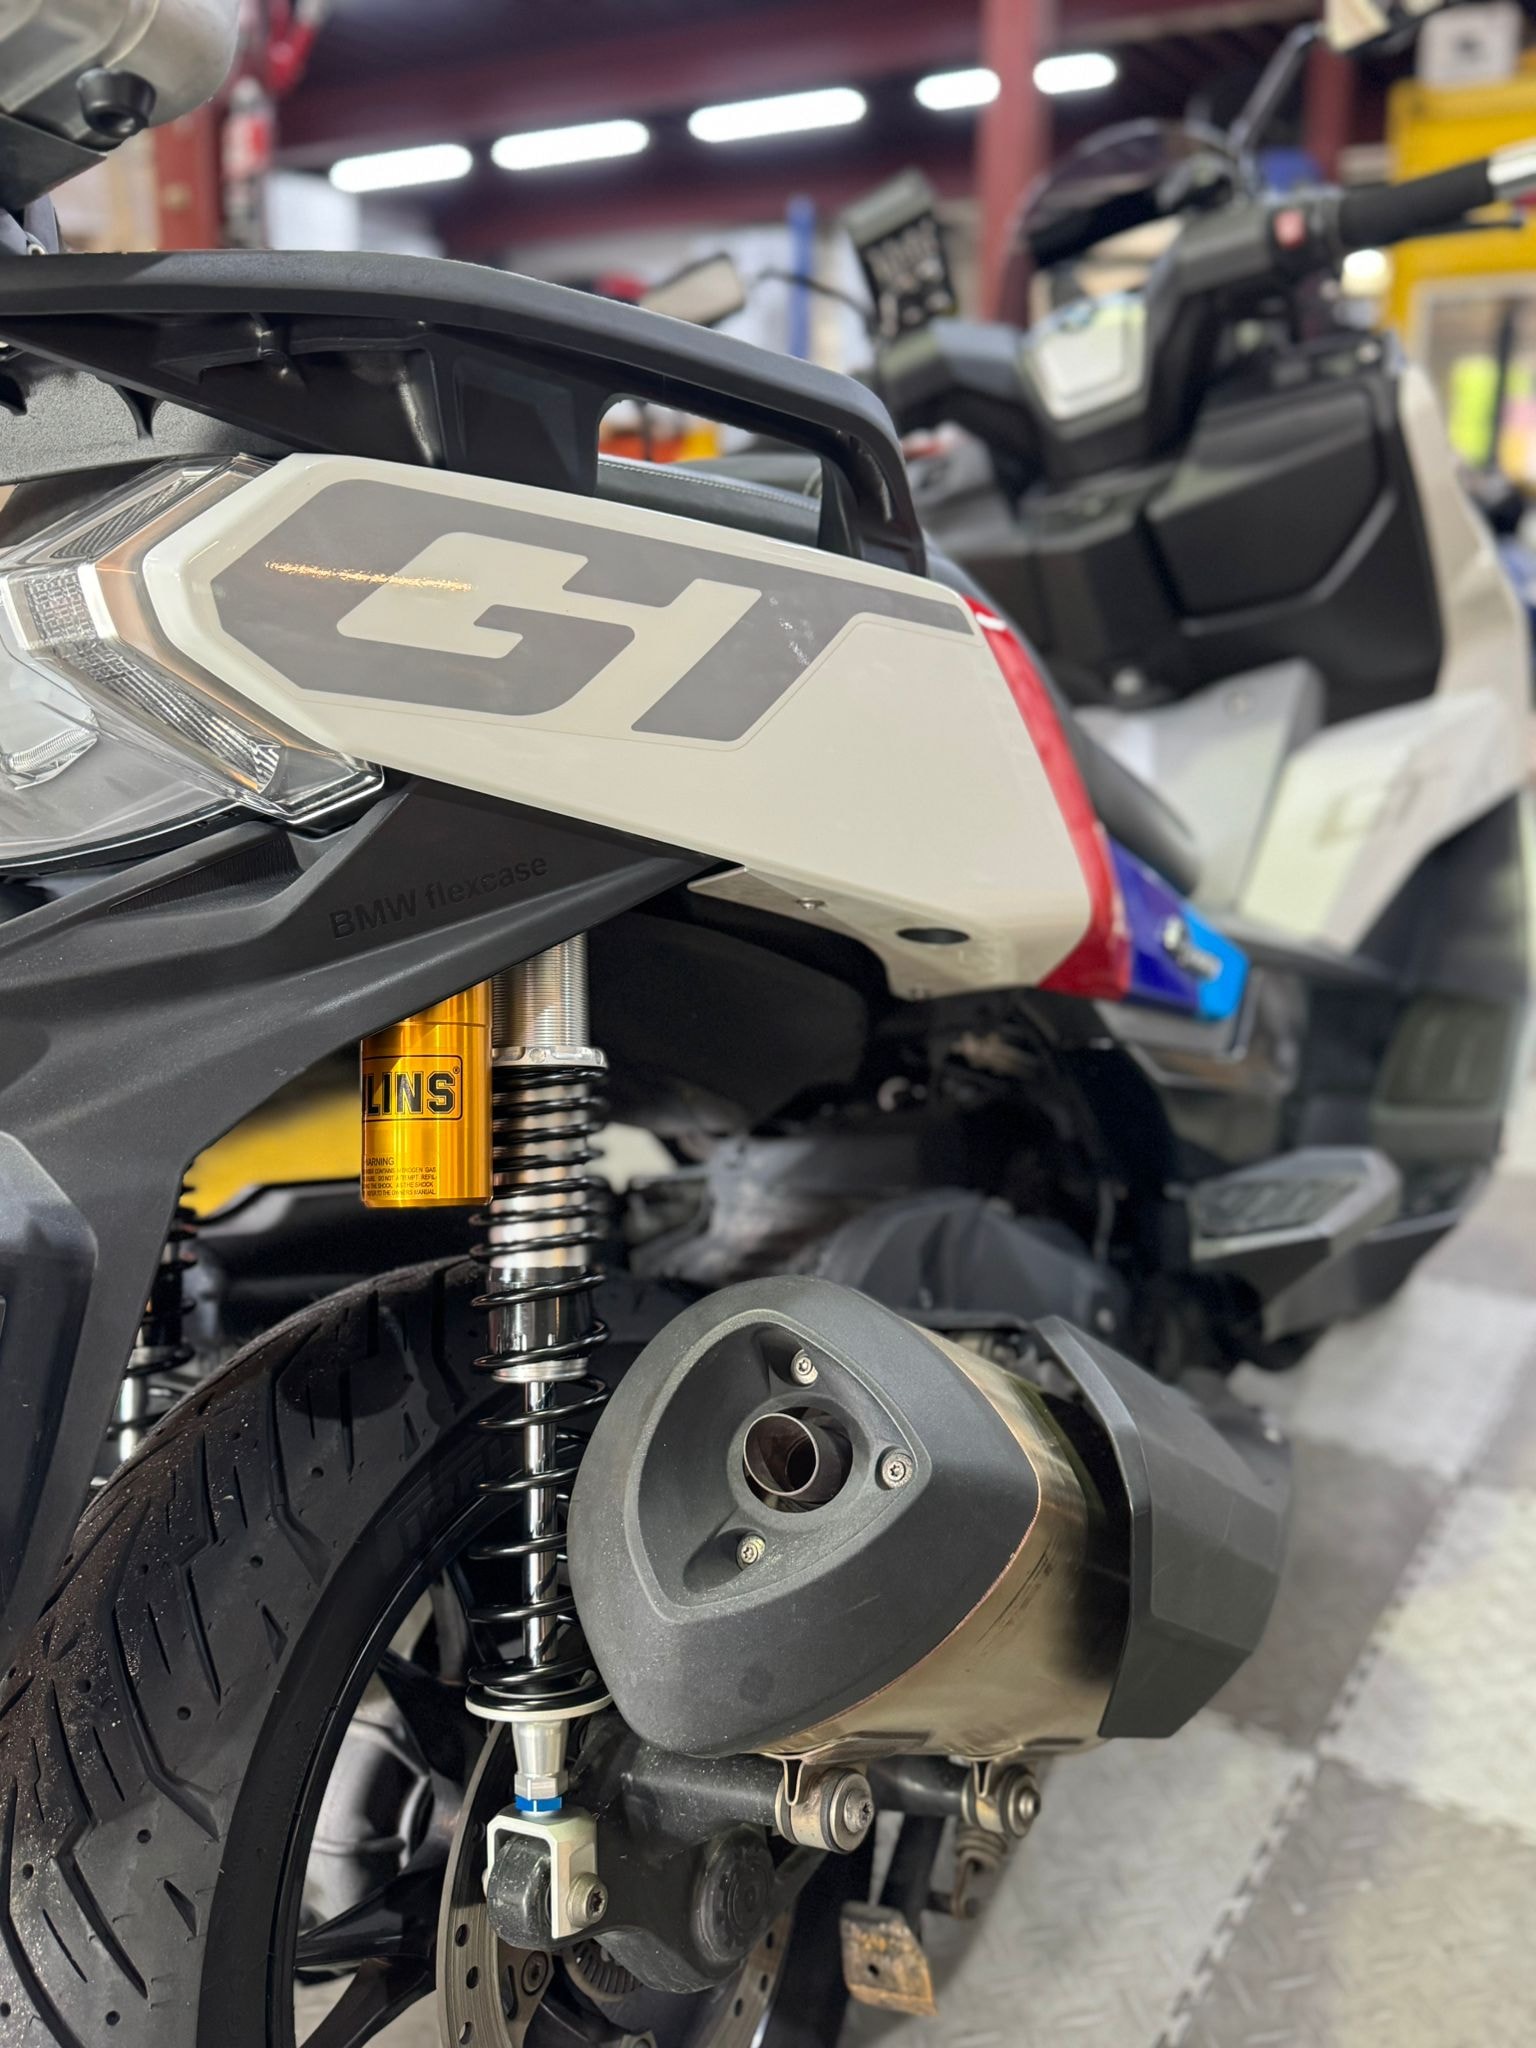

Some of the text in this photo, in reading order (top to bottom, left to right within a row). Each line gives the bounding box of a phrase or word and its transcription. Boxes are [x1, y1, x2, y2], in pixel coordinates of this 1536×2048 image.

[212, 479, 974, 741] GT
[330, 857, 548, 939] BMW flexcase
